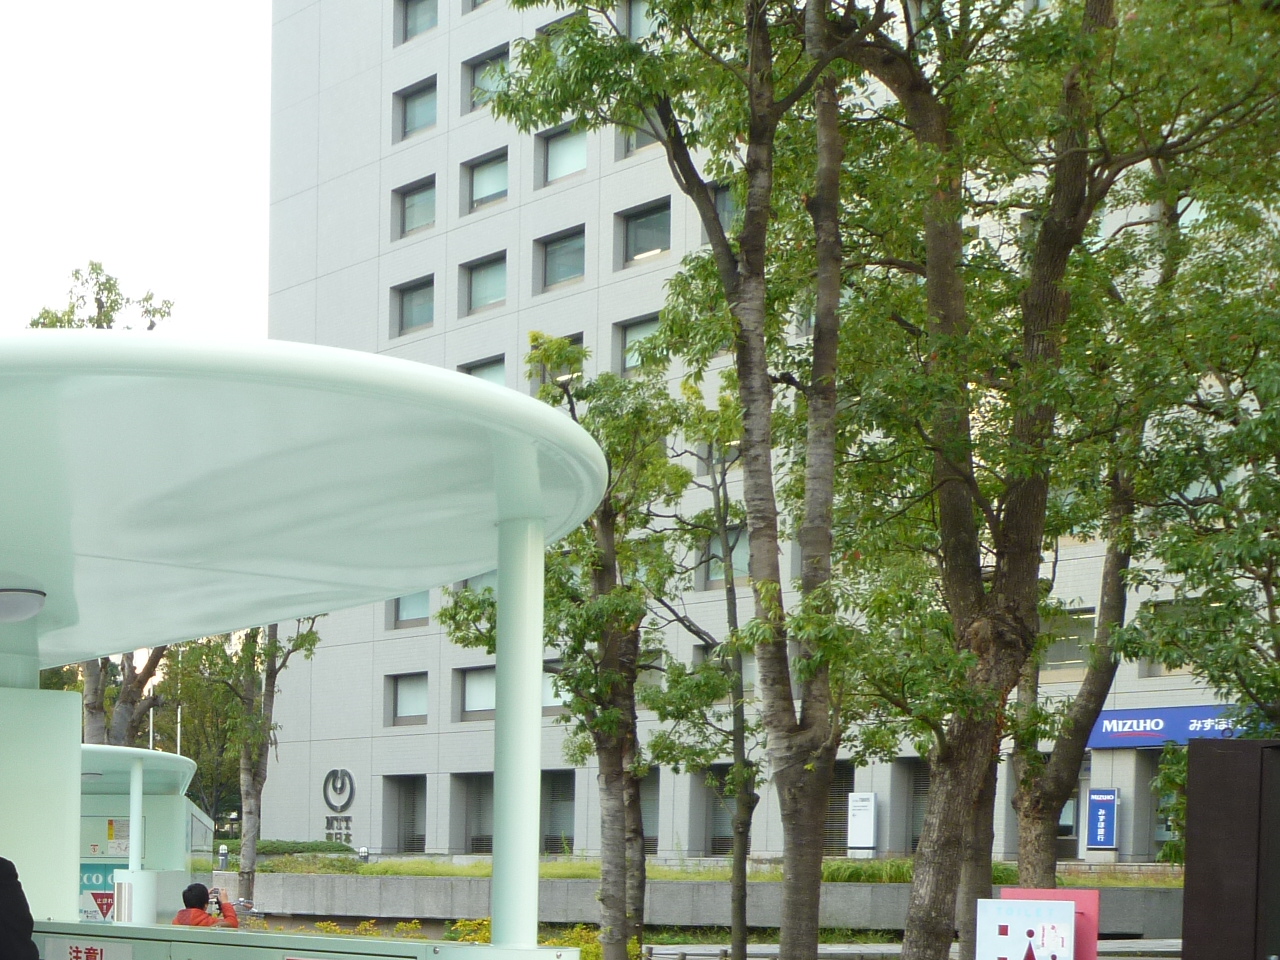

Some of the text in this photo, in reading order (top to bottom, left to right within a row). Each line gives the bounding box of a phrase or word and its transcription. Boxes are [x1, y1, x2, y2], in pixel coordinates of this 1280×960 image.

[1102, 719, 1164, 732] MIZUHO
[1189, 718, 1248, 731] みずほ
[325, 816, 352, 830] NTT
[325, 832, 352, 844] 東日本
[997, 907, 1055, 917] TOILET
